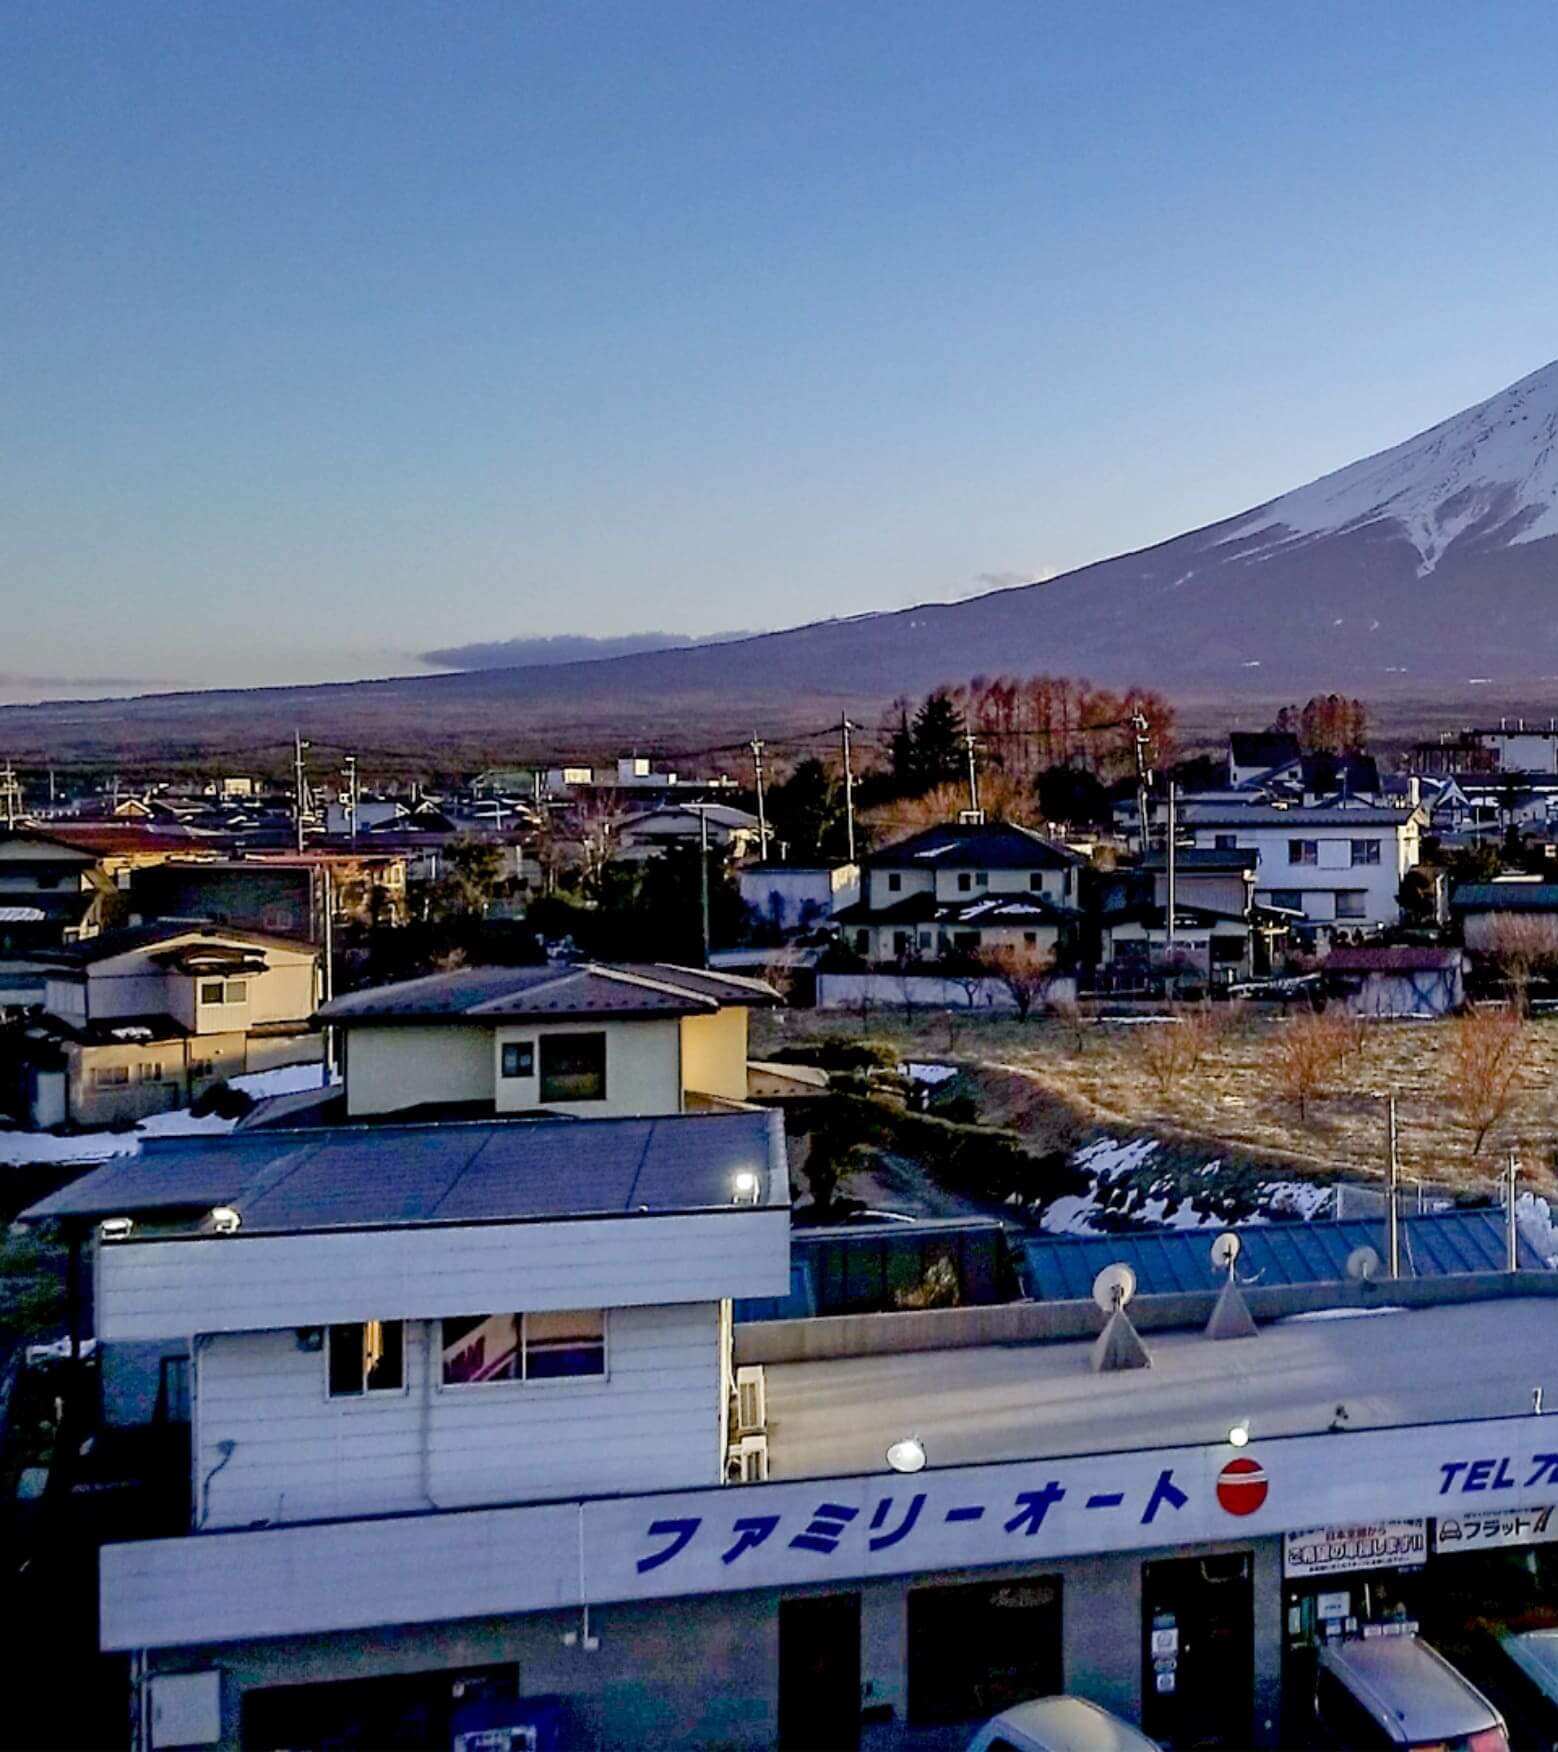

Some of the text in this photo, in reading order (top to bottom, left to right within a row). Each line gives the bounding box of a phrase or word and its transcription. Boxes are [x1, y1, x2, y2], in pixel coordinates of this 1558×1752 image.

[1440, 1457, 1515, 1494] TEL
[635, 1469, 1189, 1573] ファミリーオート
